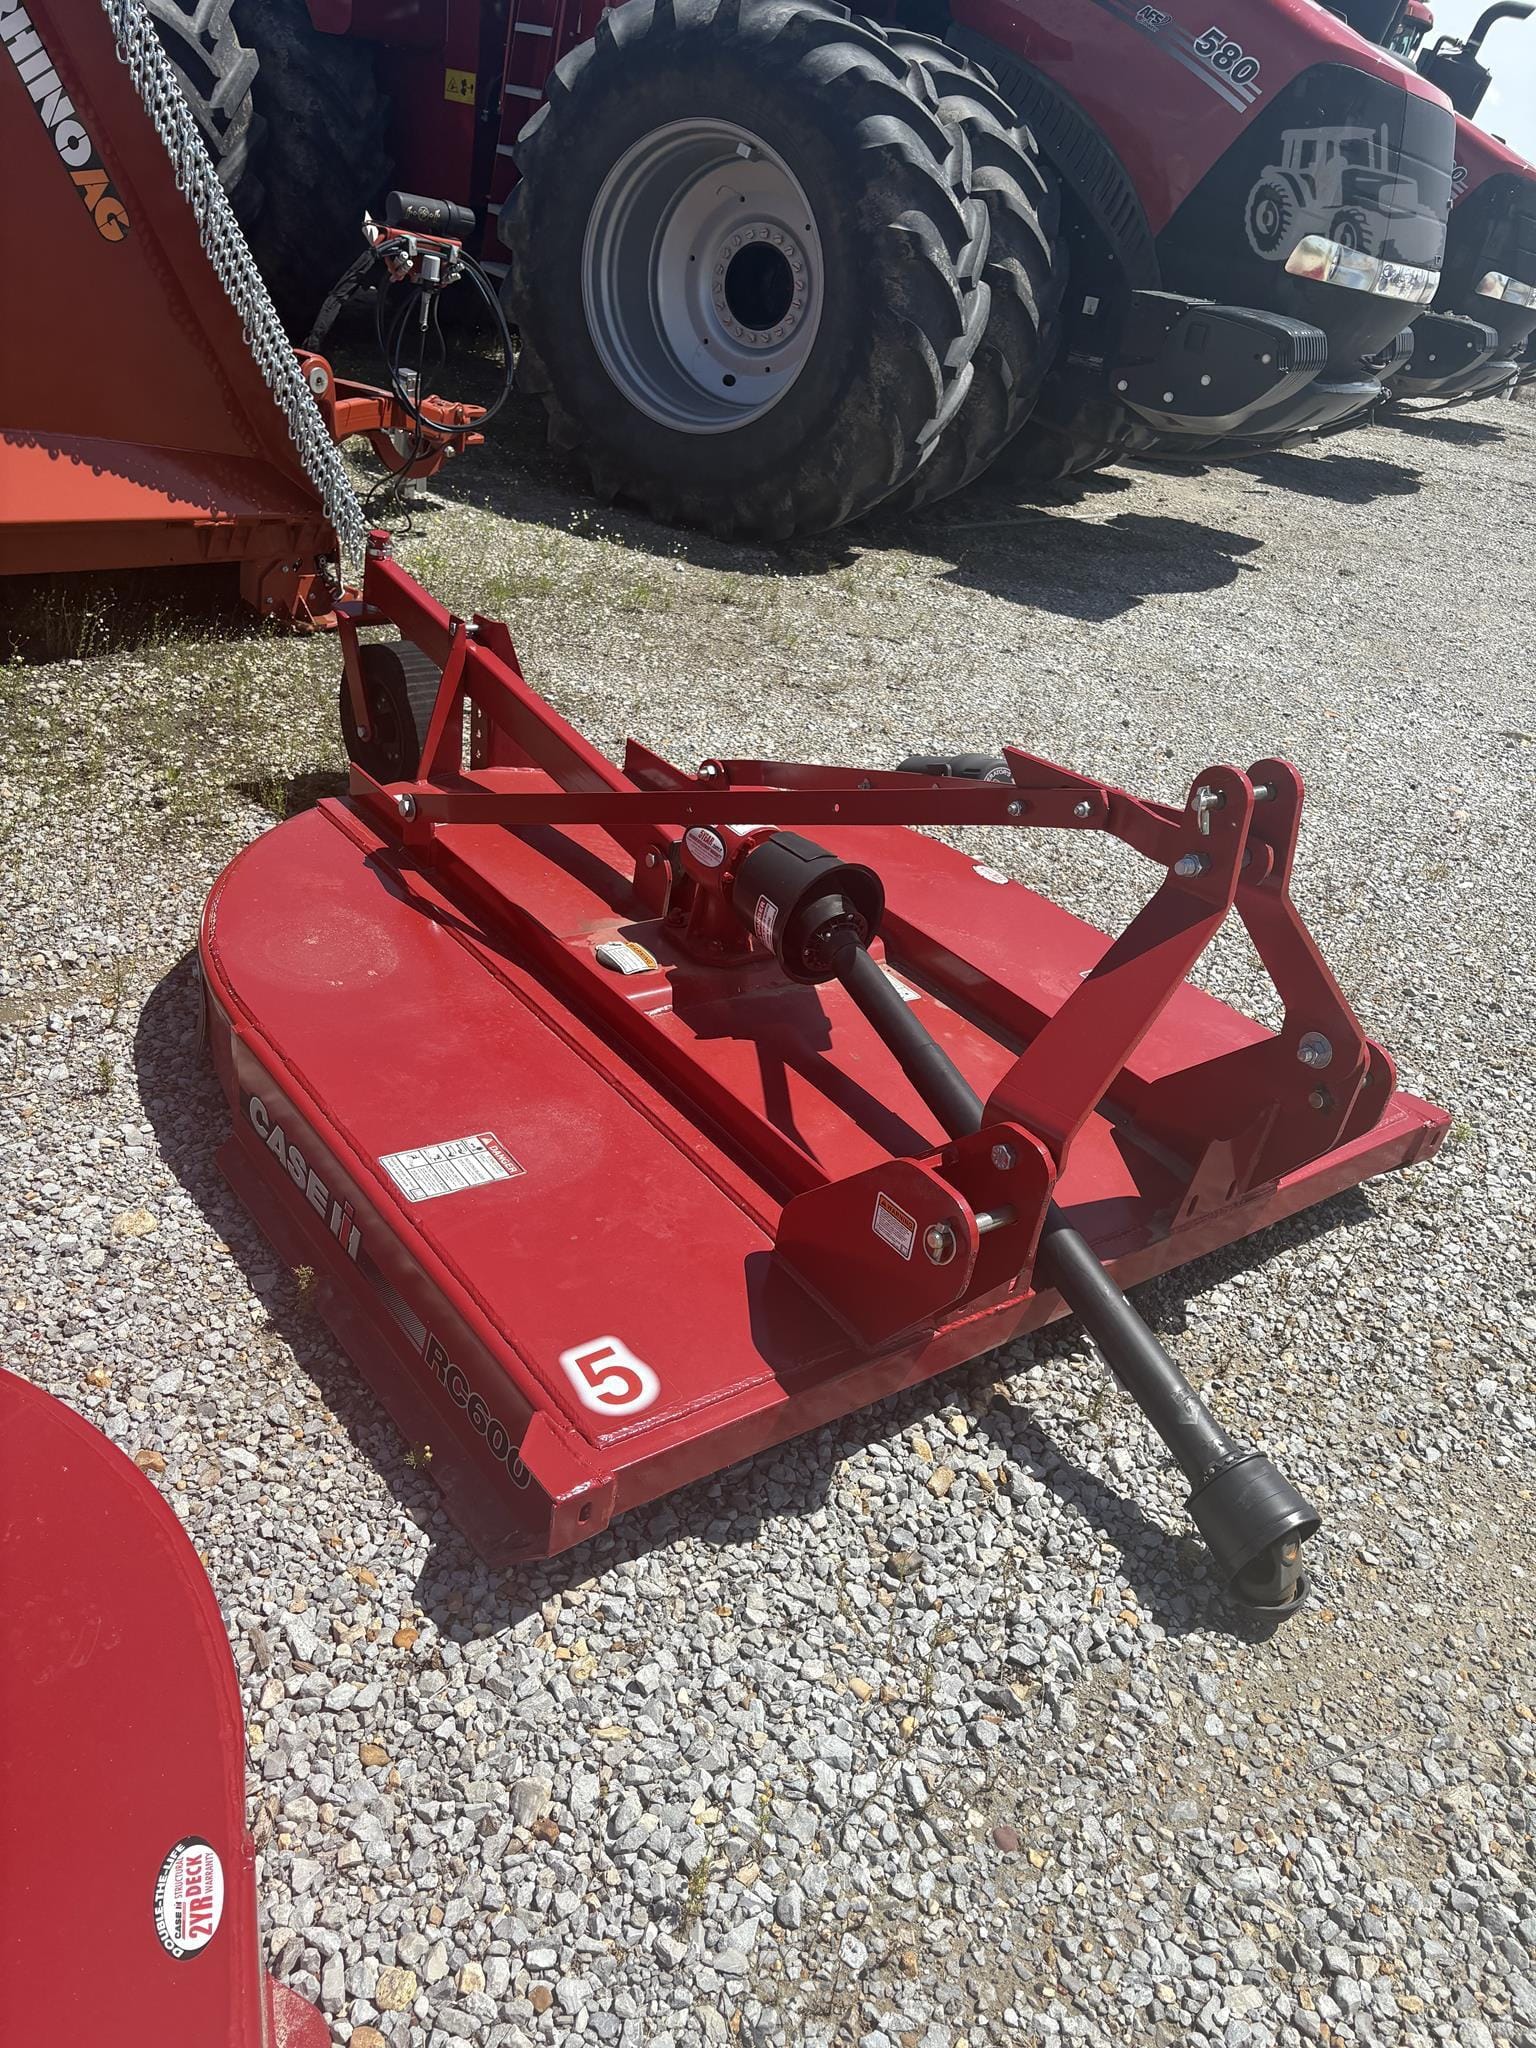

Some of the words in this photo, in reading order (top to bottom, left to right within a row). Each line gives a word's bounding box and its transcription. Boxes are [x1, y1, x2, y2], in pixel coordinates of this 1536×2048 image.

[1137, 5, 1165, 24] AFS
[1192, 26, 1264, 87] 580
[69, 168, 130, 243] AG
[249, 1096, 328, 1218] CASE
[489, 1145, 518, 1173] DANGER
[575, 1346, 643, 1405] 5
[424, 1333, 533, 1490] RC600
[174, 1856, 184, 1899] STRUCTURAL
[185, 1853, 203, 1897] DECK
[204, 1852, 214, 1894] WARRANTY
[174, 1910, 182, 1939] CASE
[188, 1895, 213, 1939] 2YR
